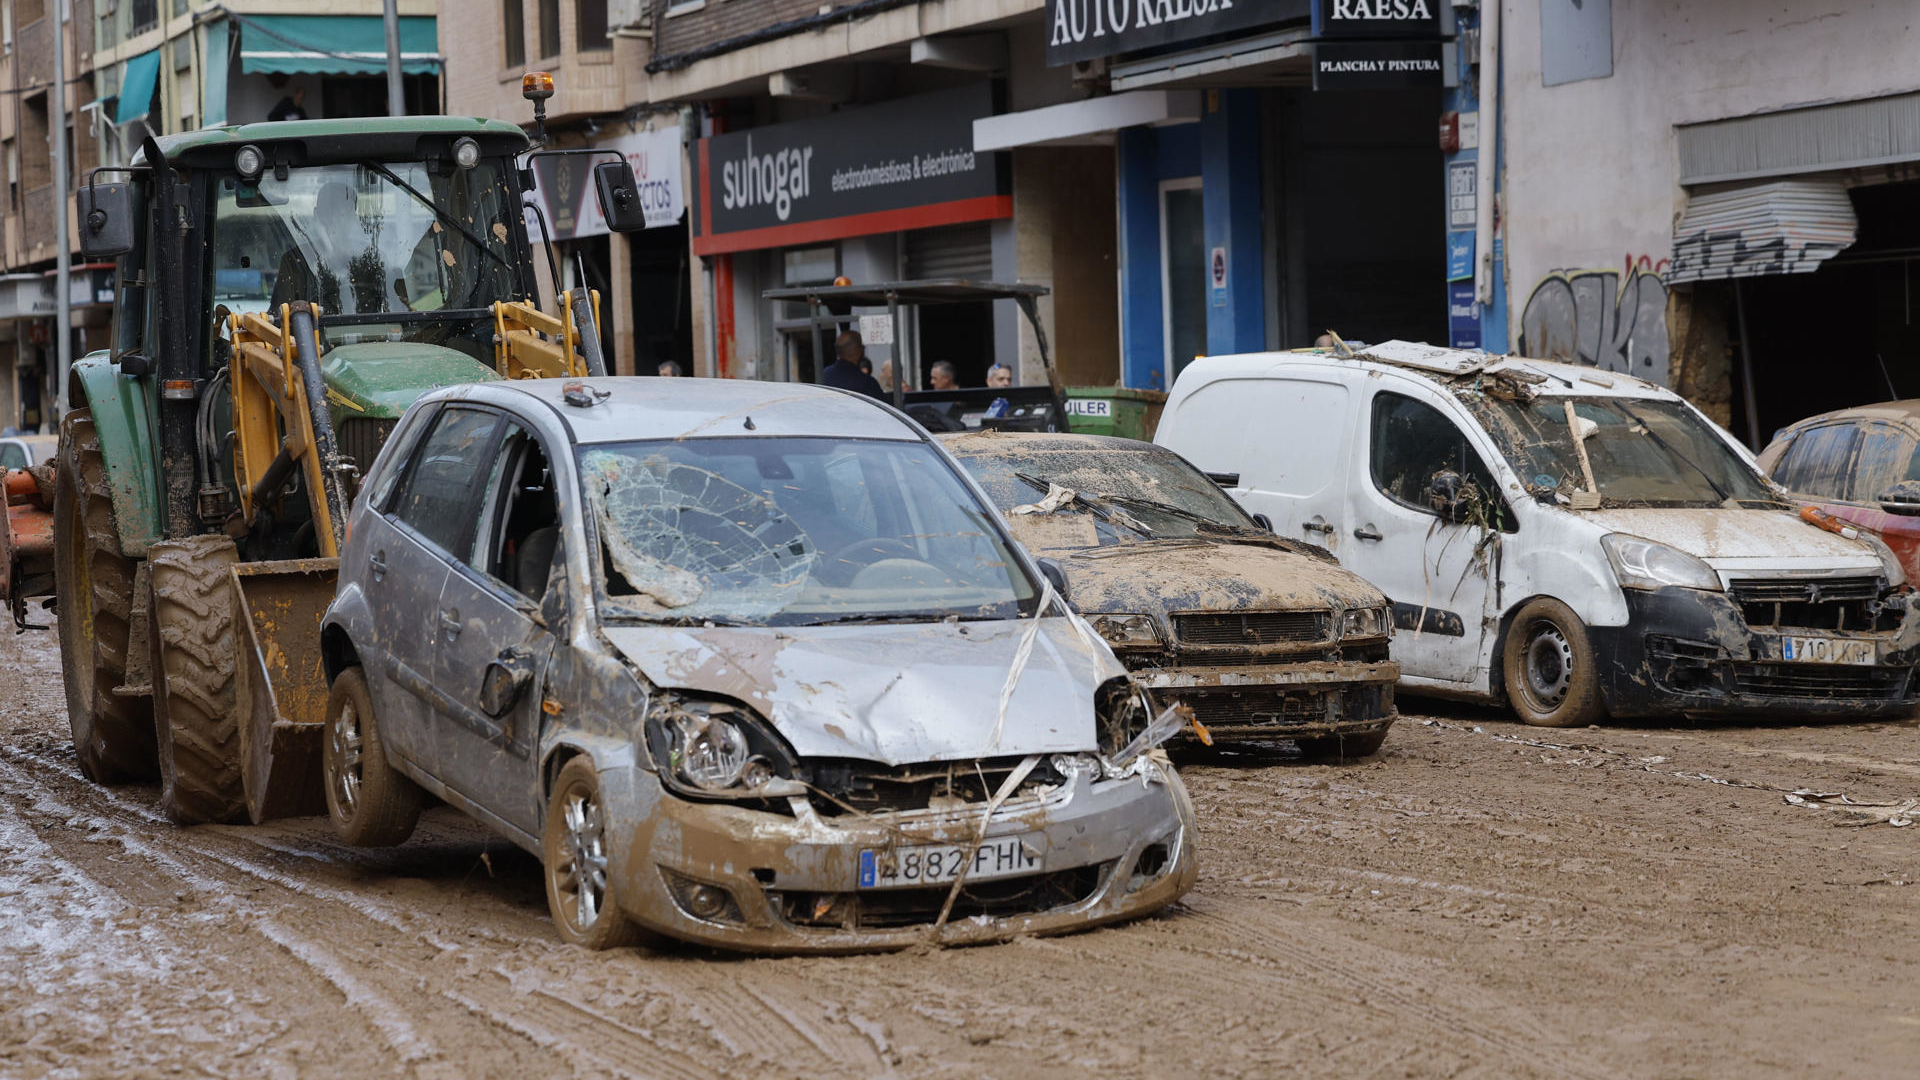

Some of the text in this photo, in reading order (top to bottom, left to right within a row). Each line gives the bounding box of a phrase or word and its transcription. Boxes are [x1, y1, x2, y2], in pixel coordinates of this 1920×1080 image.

[1331, 0, 1432, 20] RAESA
[1320, 60, 1440, 72] PLANCHA Y PINTURA
[723, 134, 813, 221] suhogar
[831, 147, 976, 192] electrodomésticos & electrónica
[1795, 639, 1836, 661] 7101
[975, 839, 1035, 874] FHN
